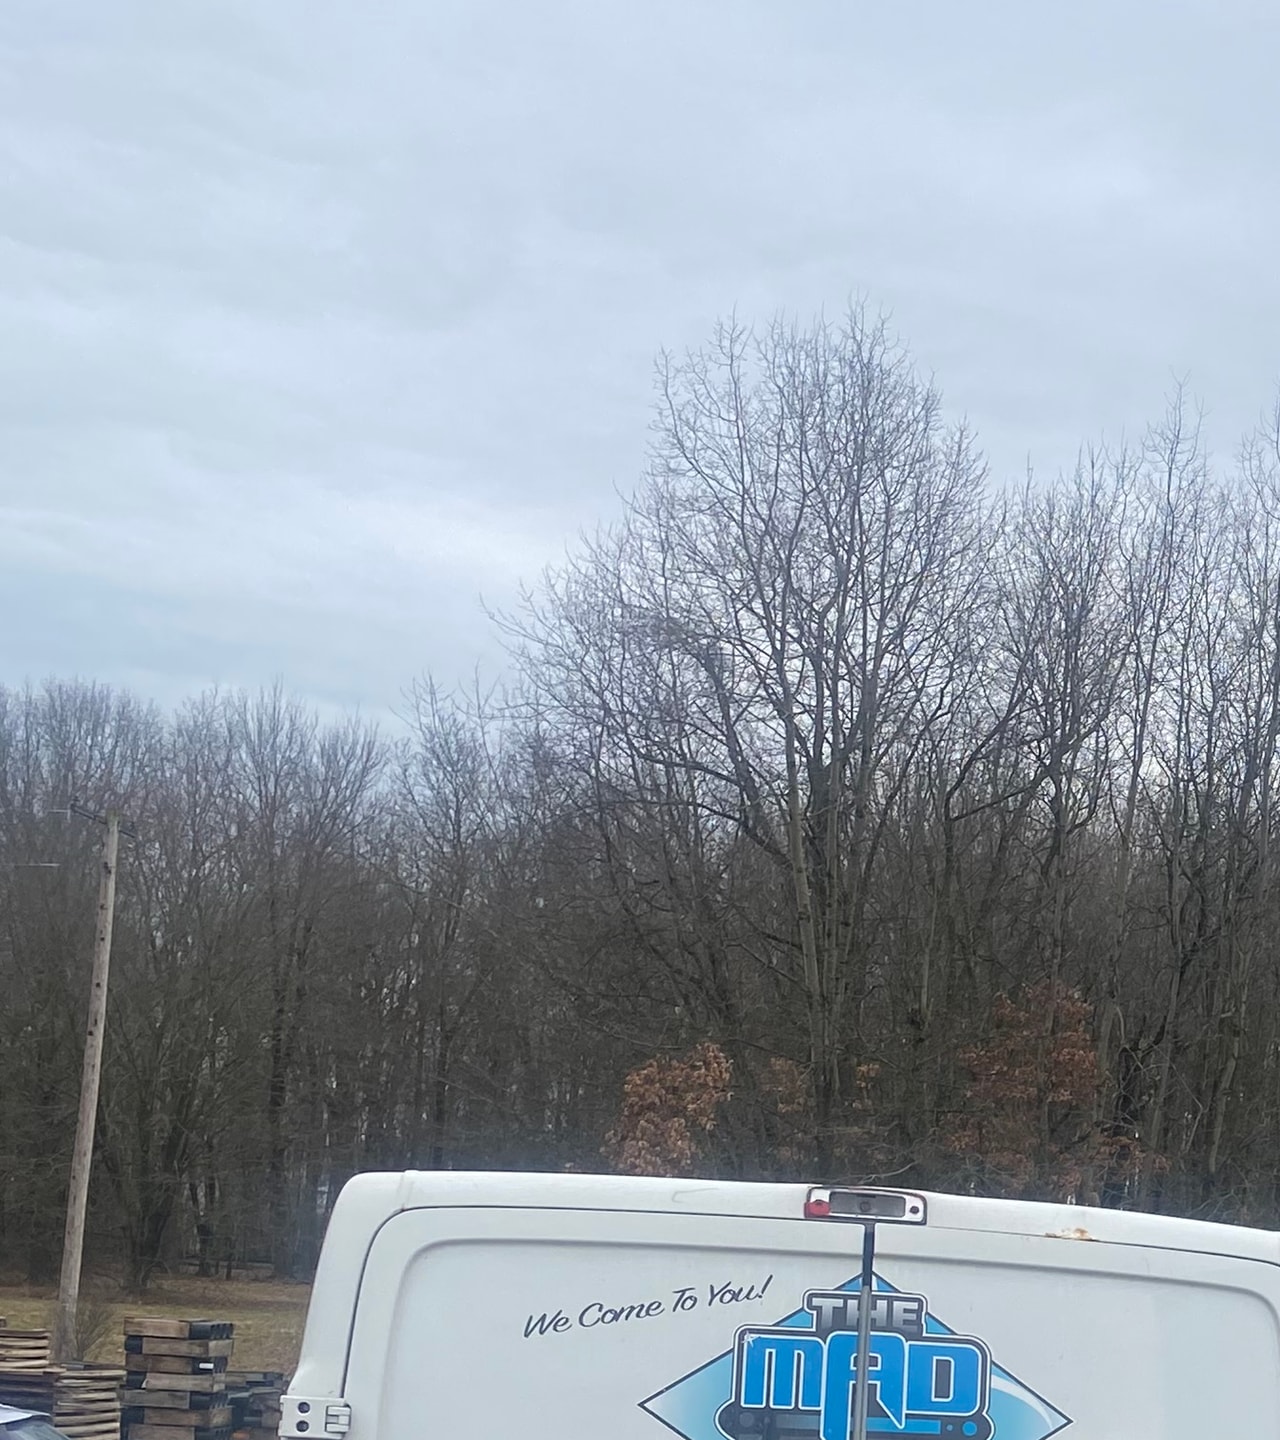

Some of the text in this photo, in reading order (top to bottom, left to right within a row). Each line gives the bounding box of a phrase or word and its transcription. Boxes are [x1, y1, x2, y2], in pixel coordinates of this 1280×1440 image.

[523, 1274, 773, 1338] We Come To You!
[811, 1297, 919, 1332] THE
